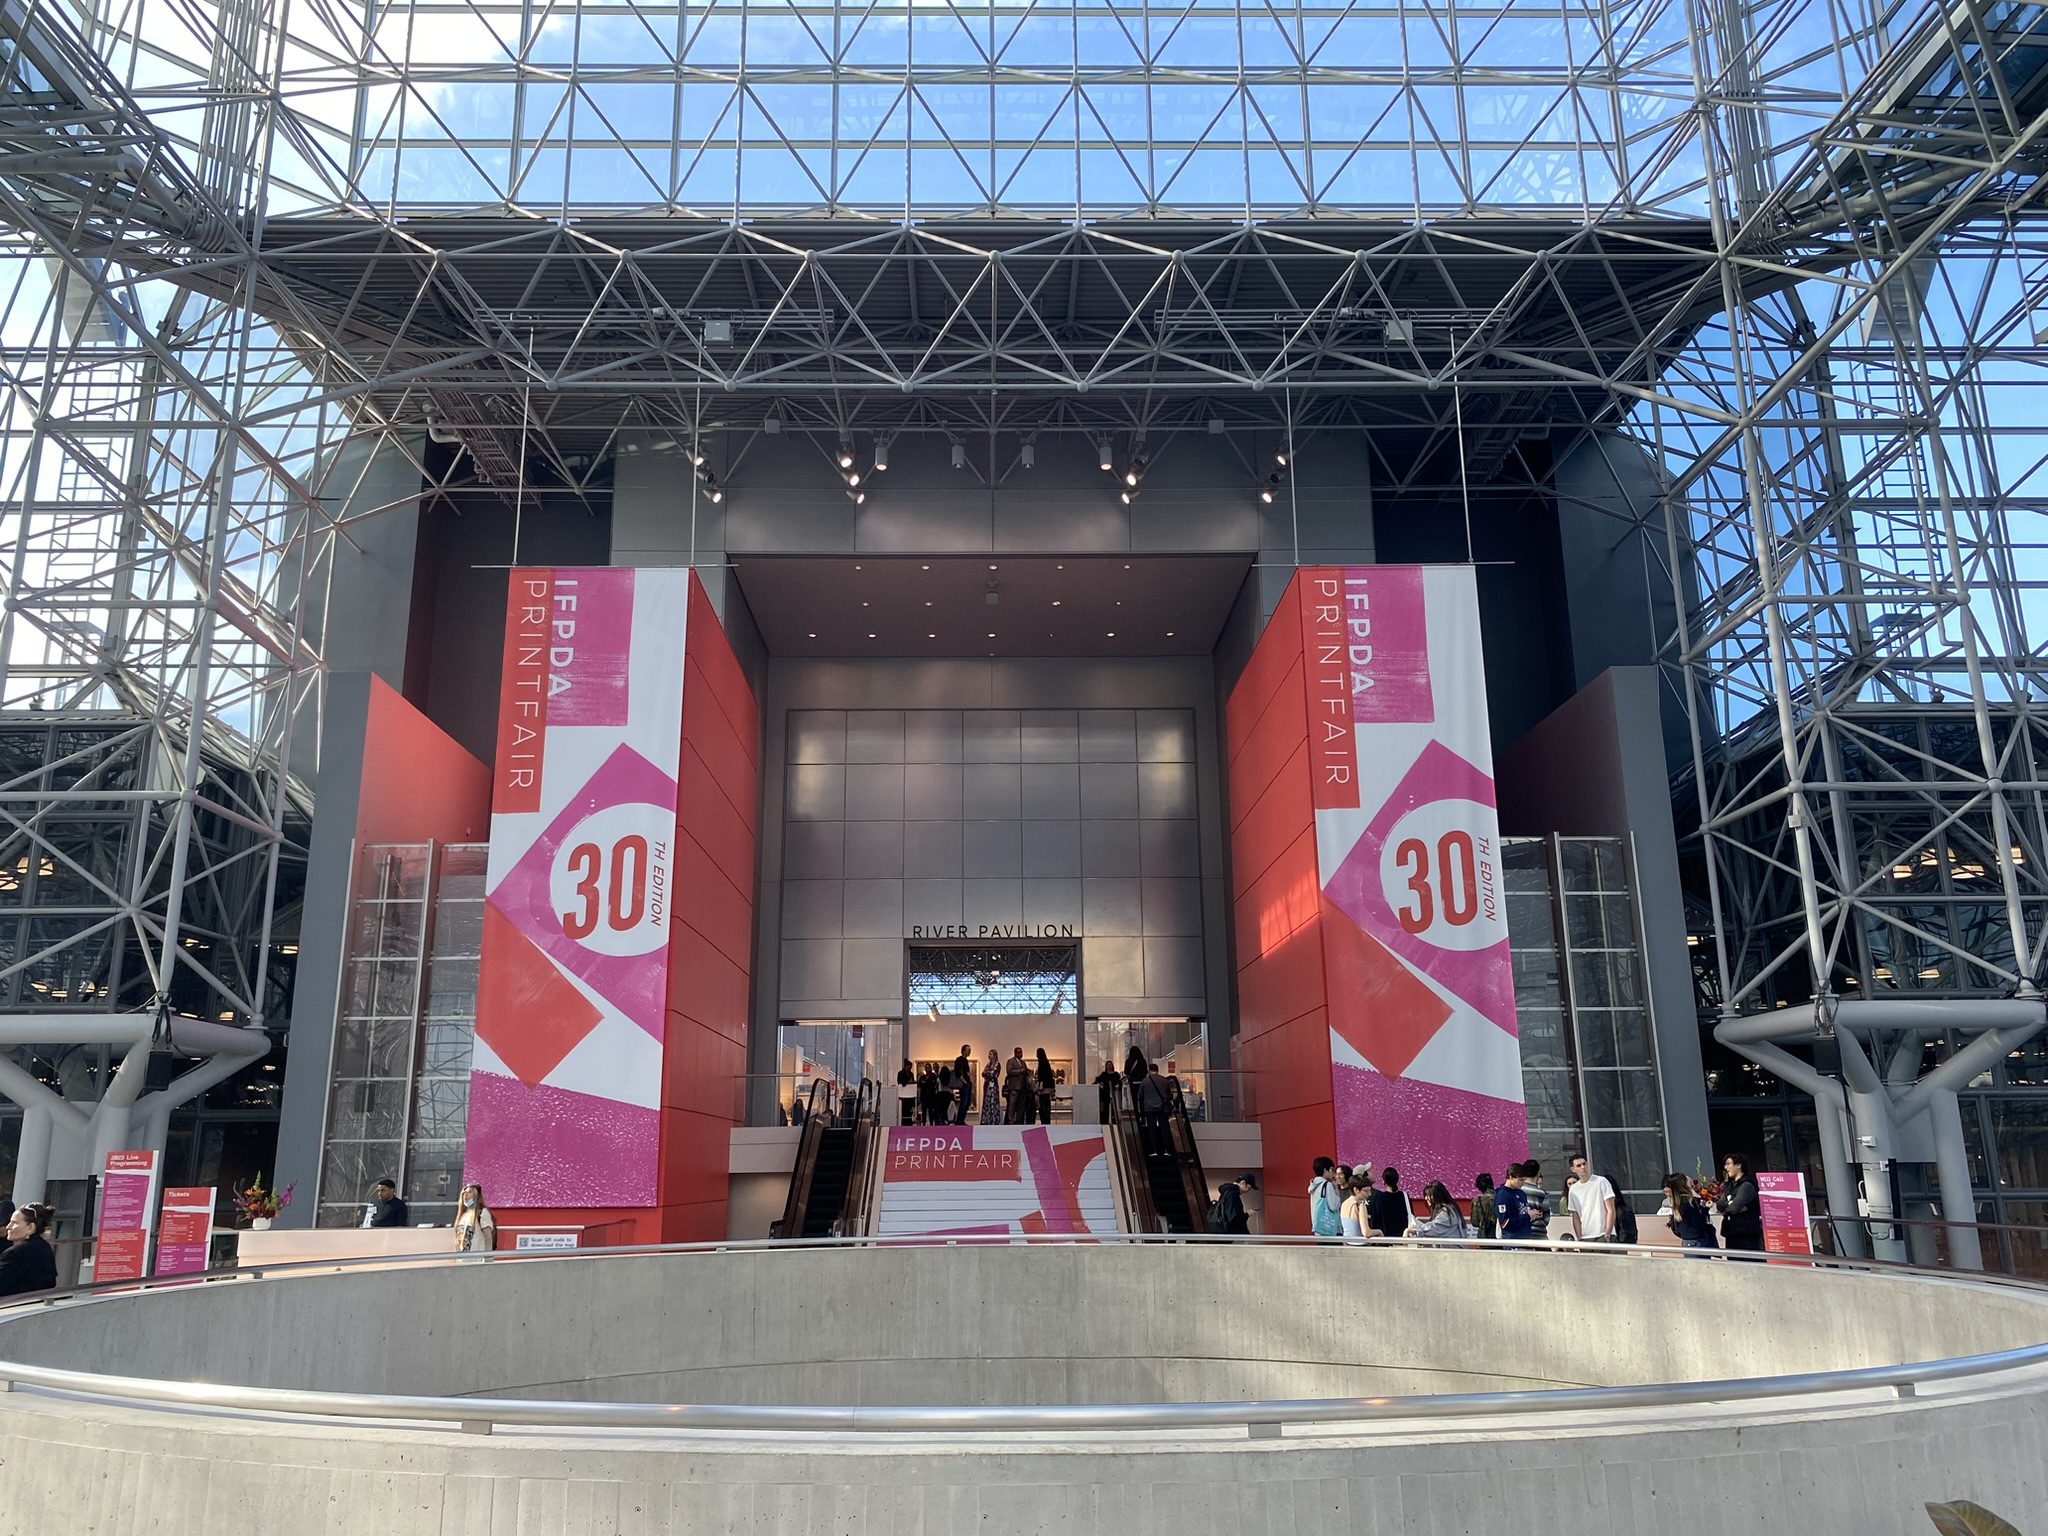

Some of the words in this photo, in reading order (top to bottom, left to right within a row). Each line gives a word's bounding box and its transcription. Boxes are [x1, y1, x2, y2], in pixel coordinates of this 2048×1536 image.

[548, 580, 578, 697] IFPDA
[1344, 579, 1375, 695] IFPDA
[508, 580, 547, 789] PRINTFAIR
[1314, 579, 1350, 785] PRINTFAIR
[653, 840, 666, 860] TH
[1477, 835, 1490, 855] TH
[562, 834, 648, 941] 30
[650, 864, 665, 927] EDITION
[1395, 829, 1479, 934] 30
[1480, 858, 1497, 922] EDITION
[912, 925, 968, 938] RIVER
[978, 924, 1073, 938] PAVILION
[894, 1154, 1013, 1169] PRINTFAIR
[896, 1137, 963, 1151] IFPDA
